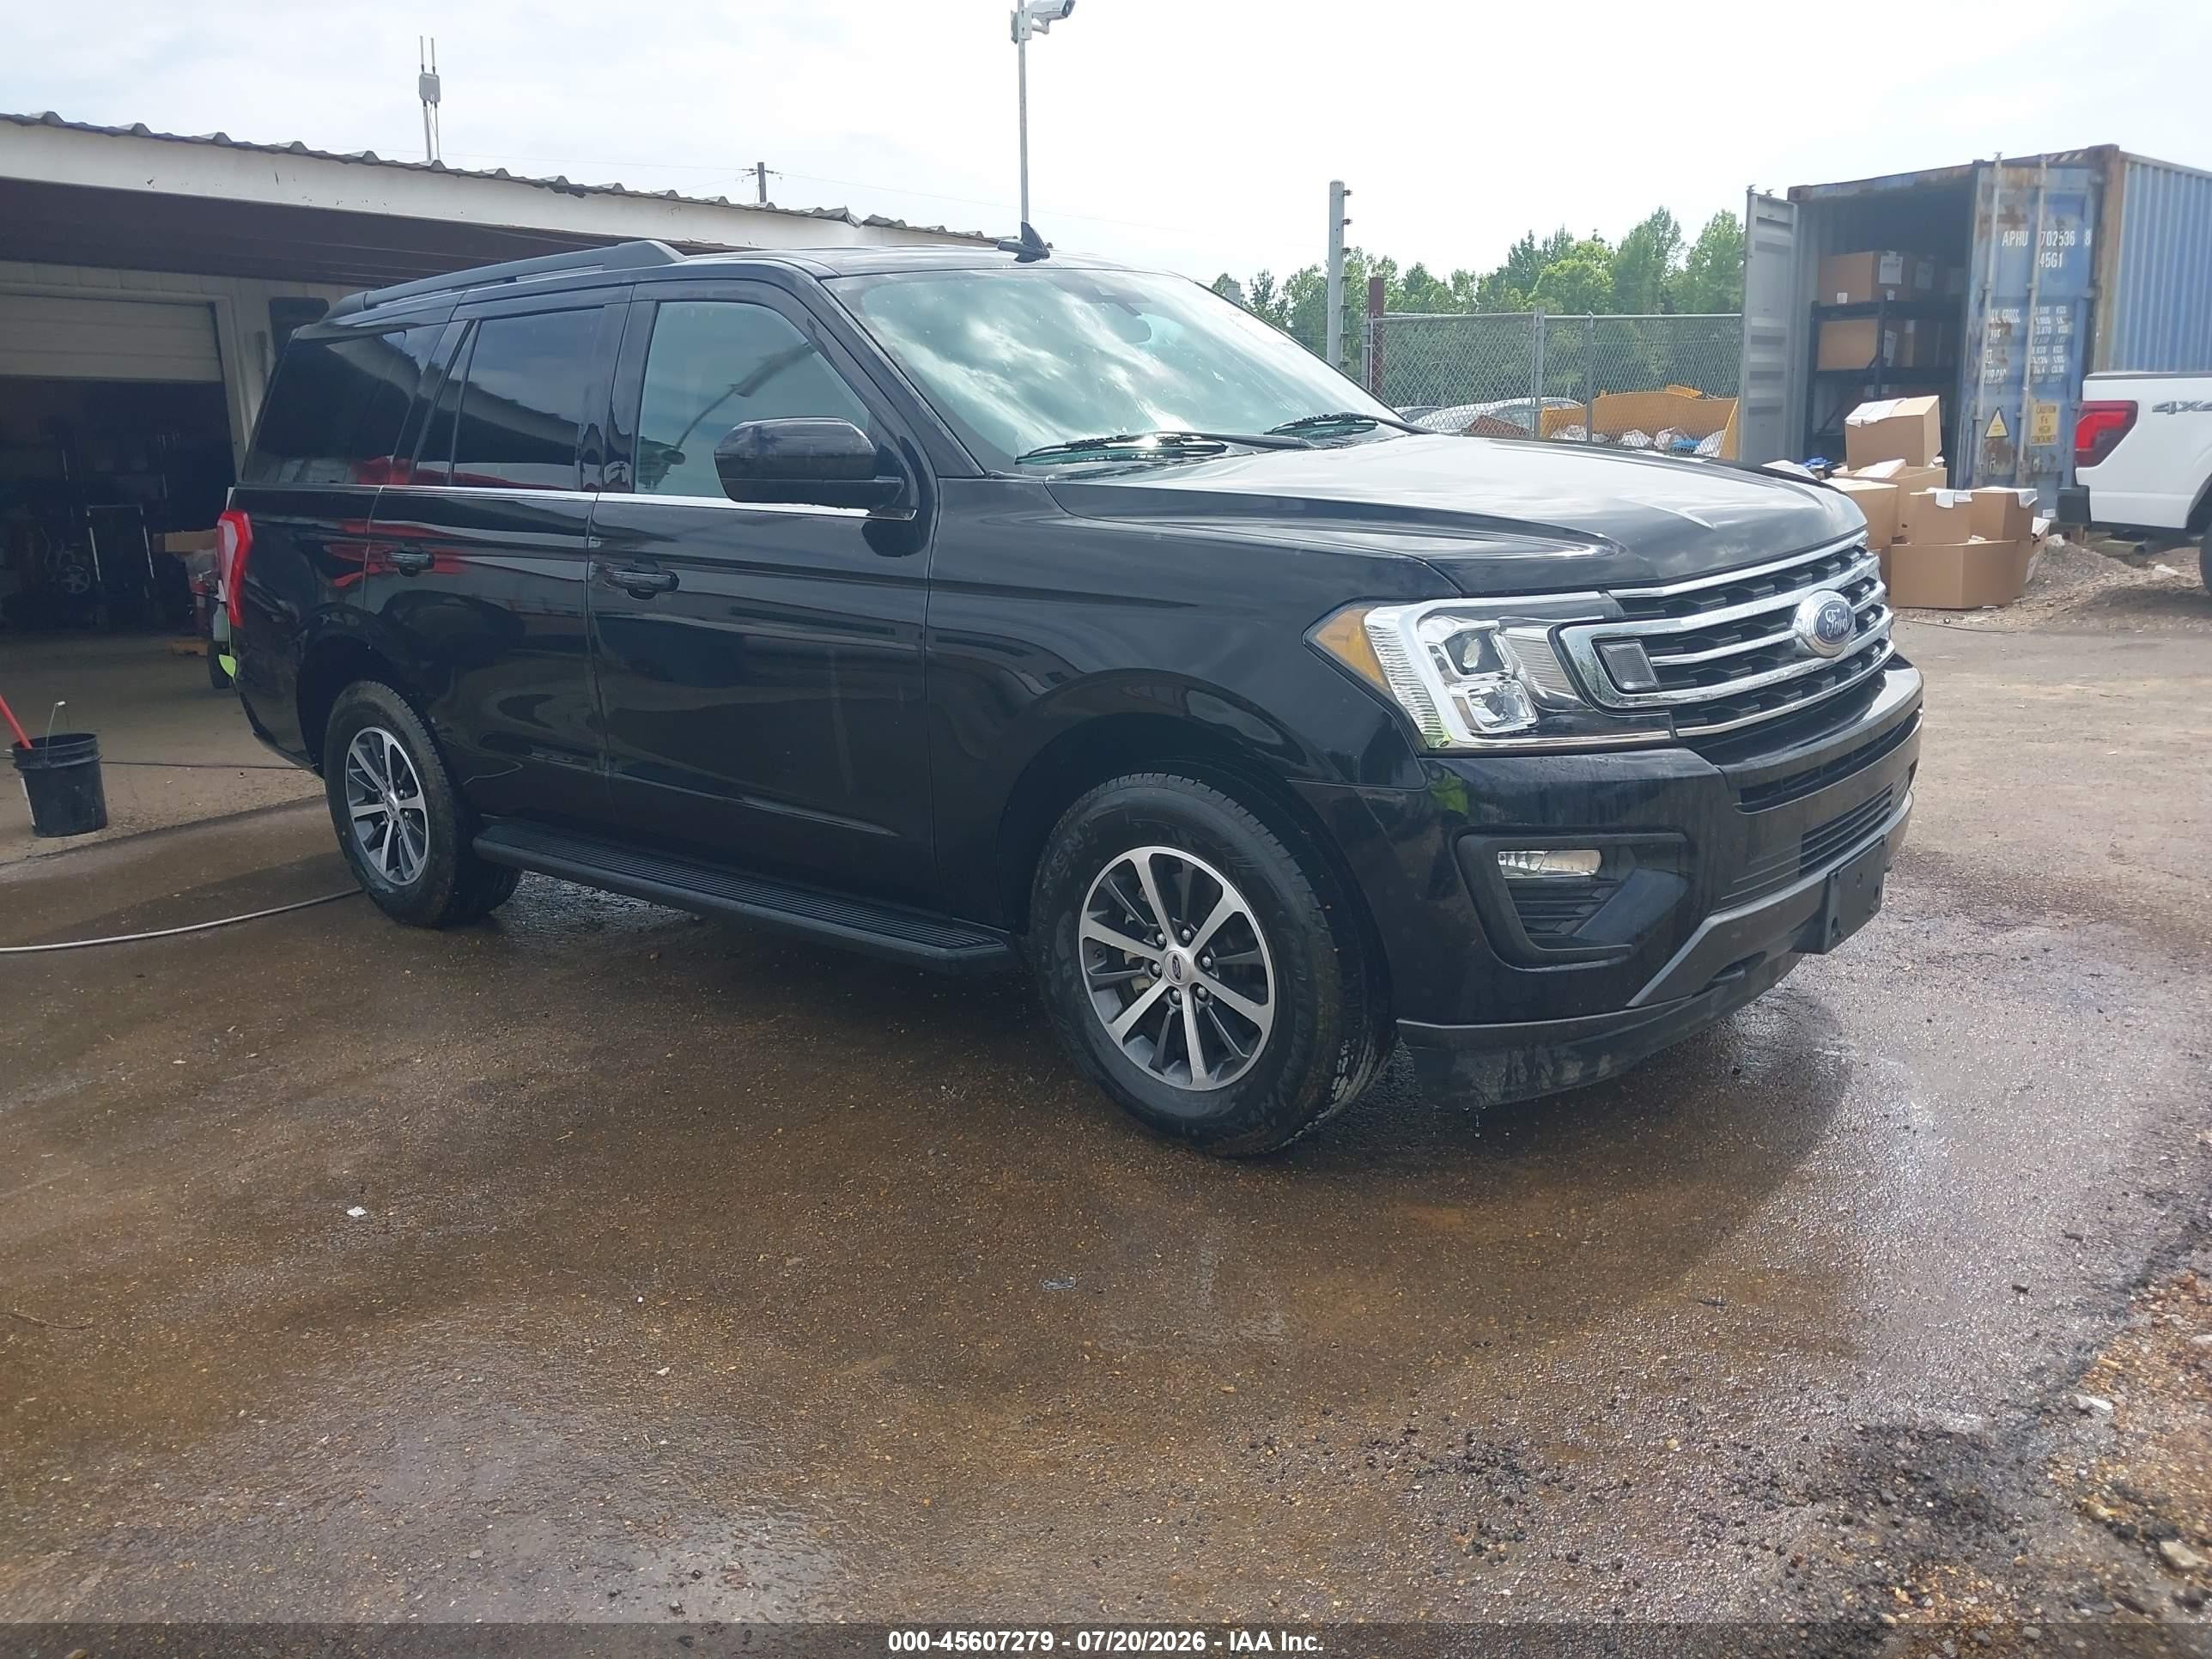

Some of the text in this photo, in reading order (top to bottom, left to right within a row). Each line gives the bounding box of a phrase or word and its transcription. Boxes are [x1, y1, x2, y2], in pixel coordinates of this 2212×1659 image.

[2002, 230, 2029, 246] APHU
[2039, 252, 2063, 268] 45G1
[1826, 608, 1850, 638] Ford
